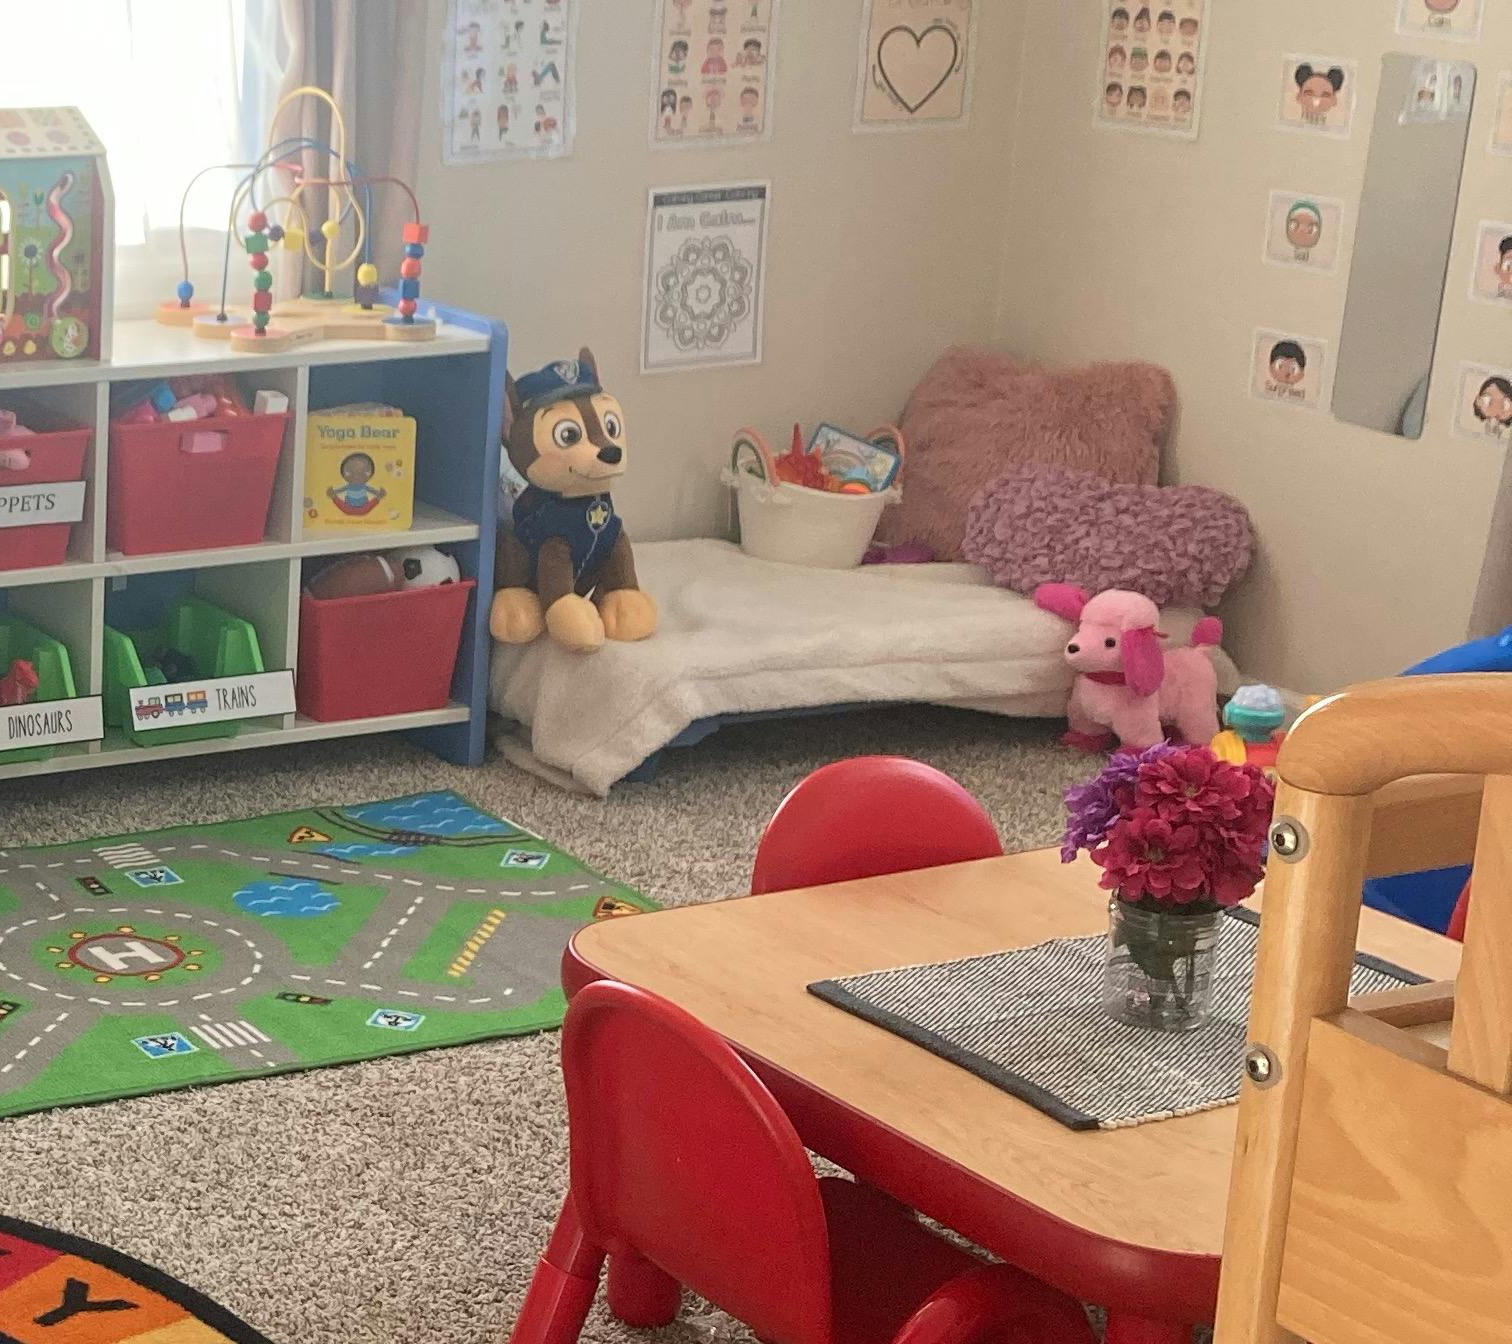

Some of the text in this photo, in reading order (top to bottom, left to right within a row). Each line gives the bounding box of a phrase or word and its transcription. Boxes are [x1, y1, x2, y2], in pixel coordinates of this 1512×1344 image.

[317, 425, 400, 441] Yoga Bear
[215, 685, 257, 711] TRAINS
[8, 710, 73, 741] DINOSAURS
[87, 941, 165, 970] H
[35, 1277, 138, 1327] Y
